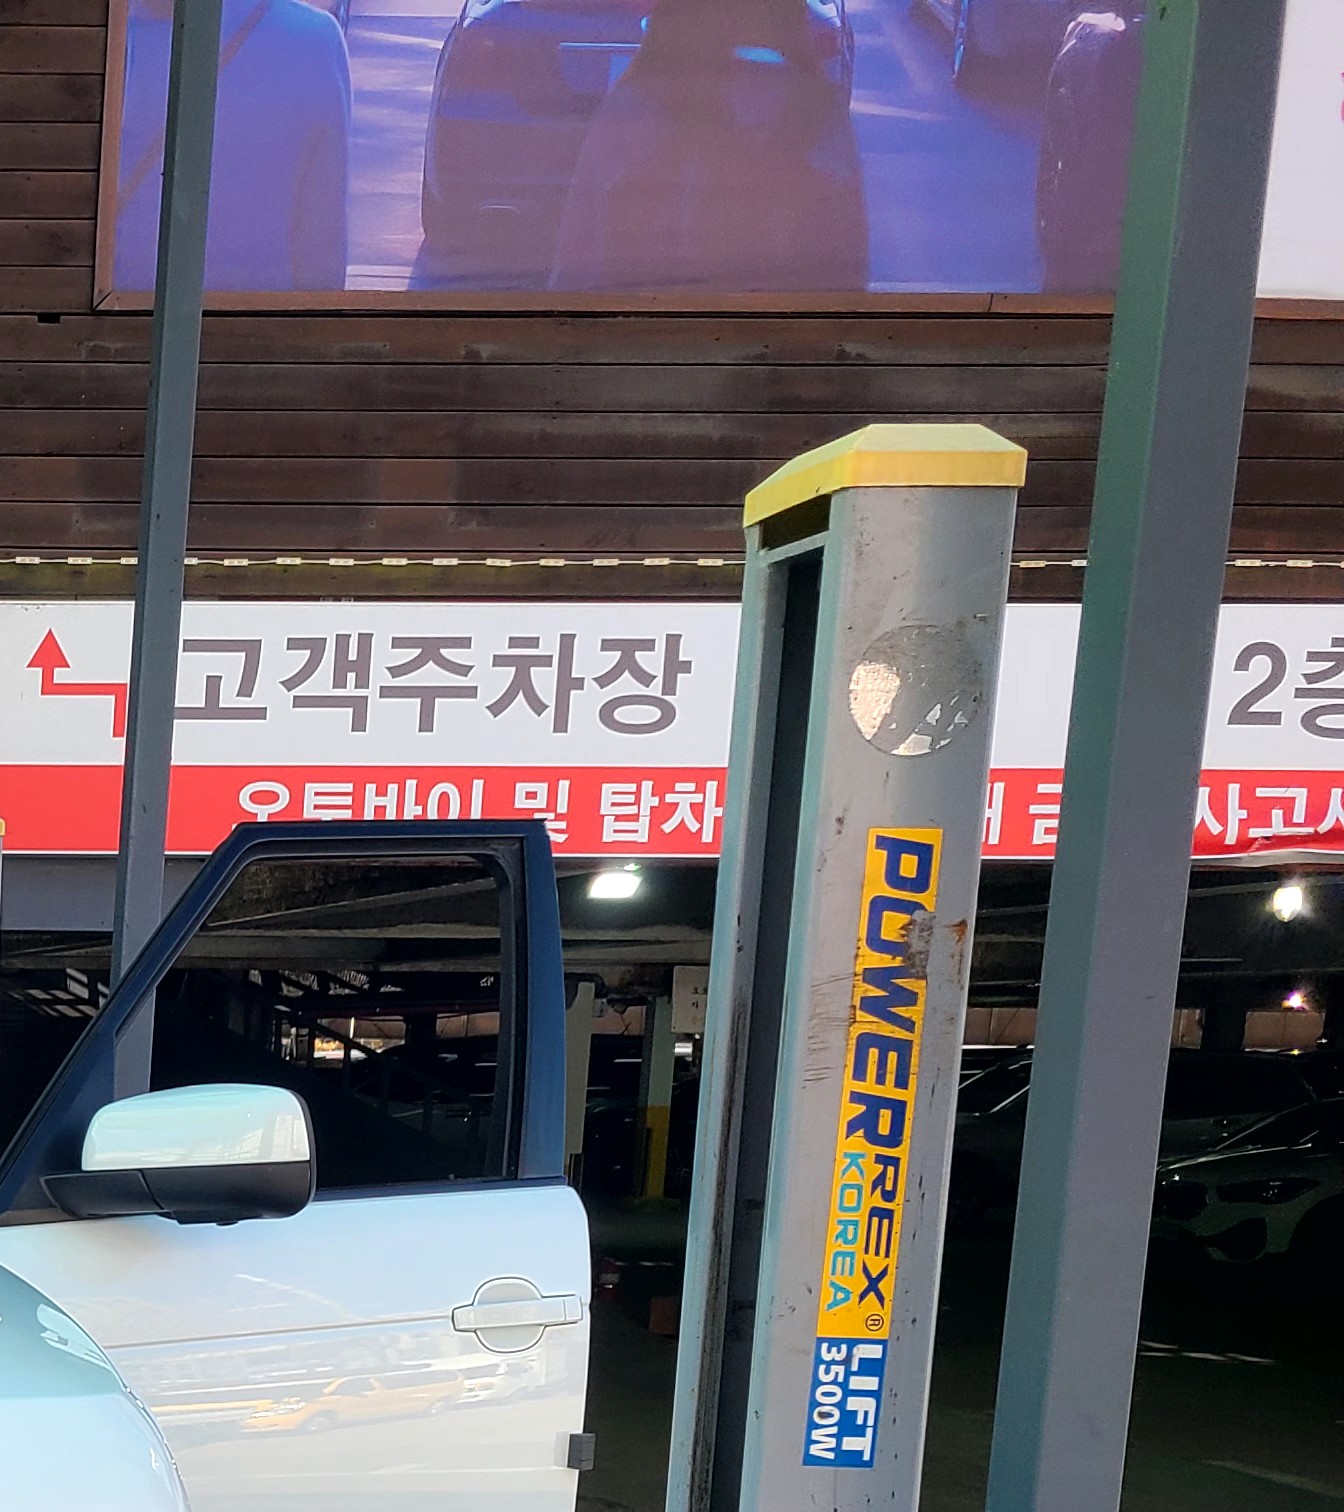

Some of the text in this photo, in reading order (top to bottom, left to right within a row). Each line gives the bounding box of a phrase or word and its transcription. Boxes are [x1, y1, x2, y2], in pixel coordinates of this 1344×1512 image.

[174, 632, 692, 735] 고객주차장
[513, 779, 571, 843] 및
[827, 1151, 866, 1310] KOREA
[809, 1343, 847, 1460] 3500W
[841, 1344, 883, 1460] LIFT
